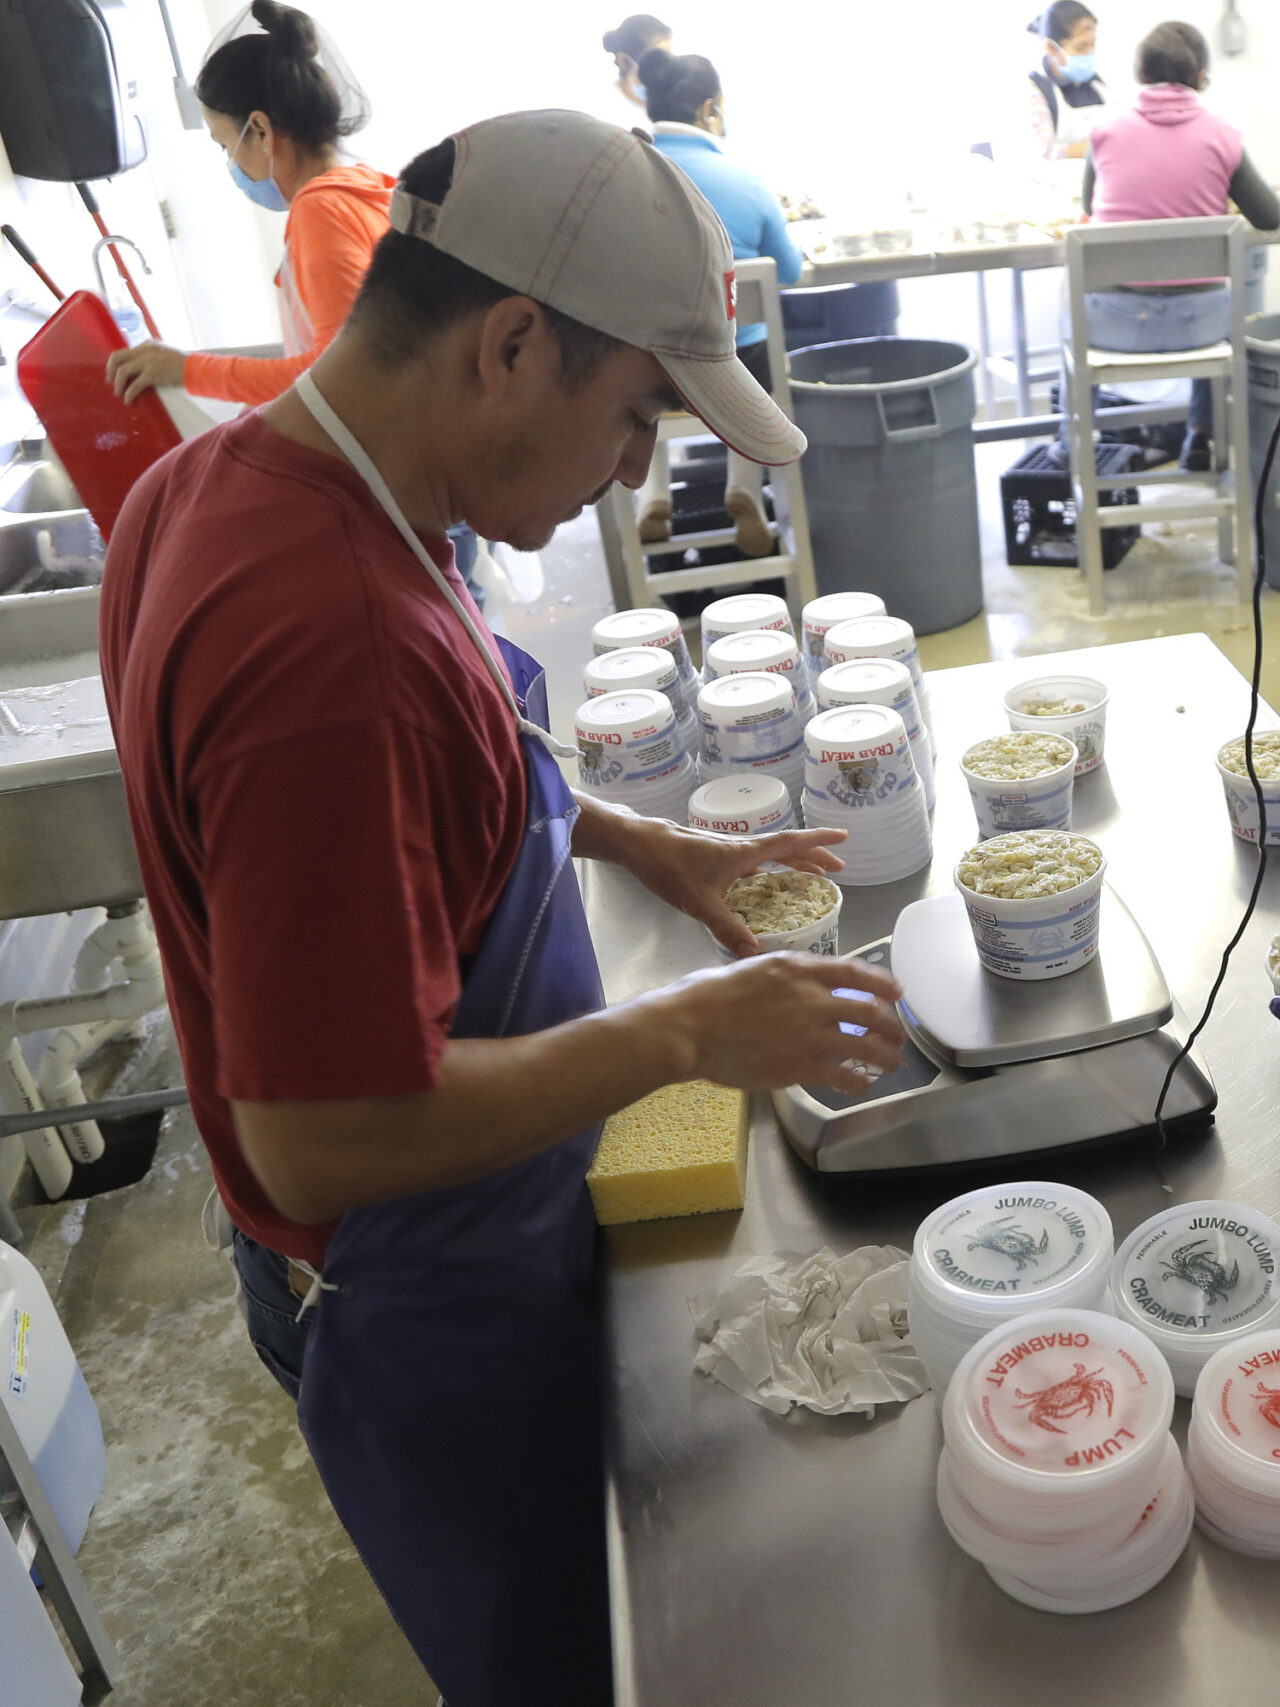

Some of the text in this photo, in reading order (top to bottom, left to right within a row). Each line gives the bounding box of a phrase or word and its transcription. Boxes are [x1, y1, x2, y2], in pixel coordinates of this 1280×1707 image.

[589, 732, 622, 745] CRAB
[820, 743, 893, 763] CRAB MEAT
[875, 772, 898, 800] OLD
[712, 820, 749, 833] CRAB
[994, 1197, 1086, 1239] JUMBO LUMP
[1189, 1217, 1275, 1274] JUMBO LUMP
[933, 1248, 1021, 1292] CRABMEAT
[1130, 1277, 1211, 1328] CRABMEAT
[986, 1332, 1090, 1388] CRABMEAT
[1065, 1428, 1135, 1466] LUMP
